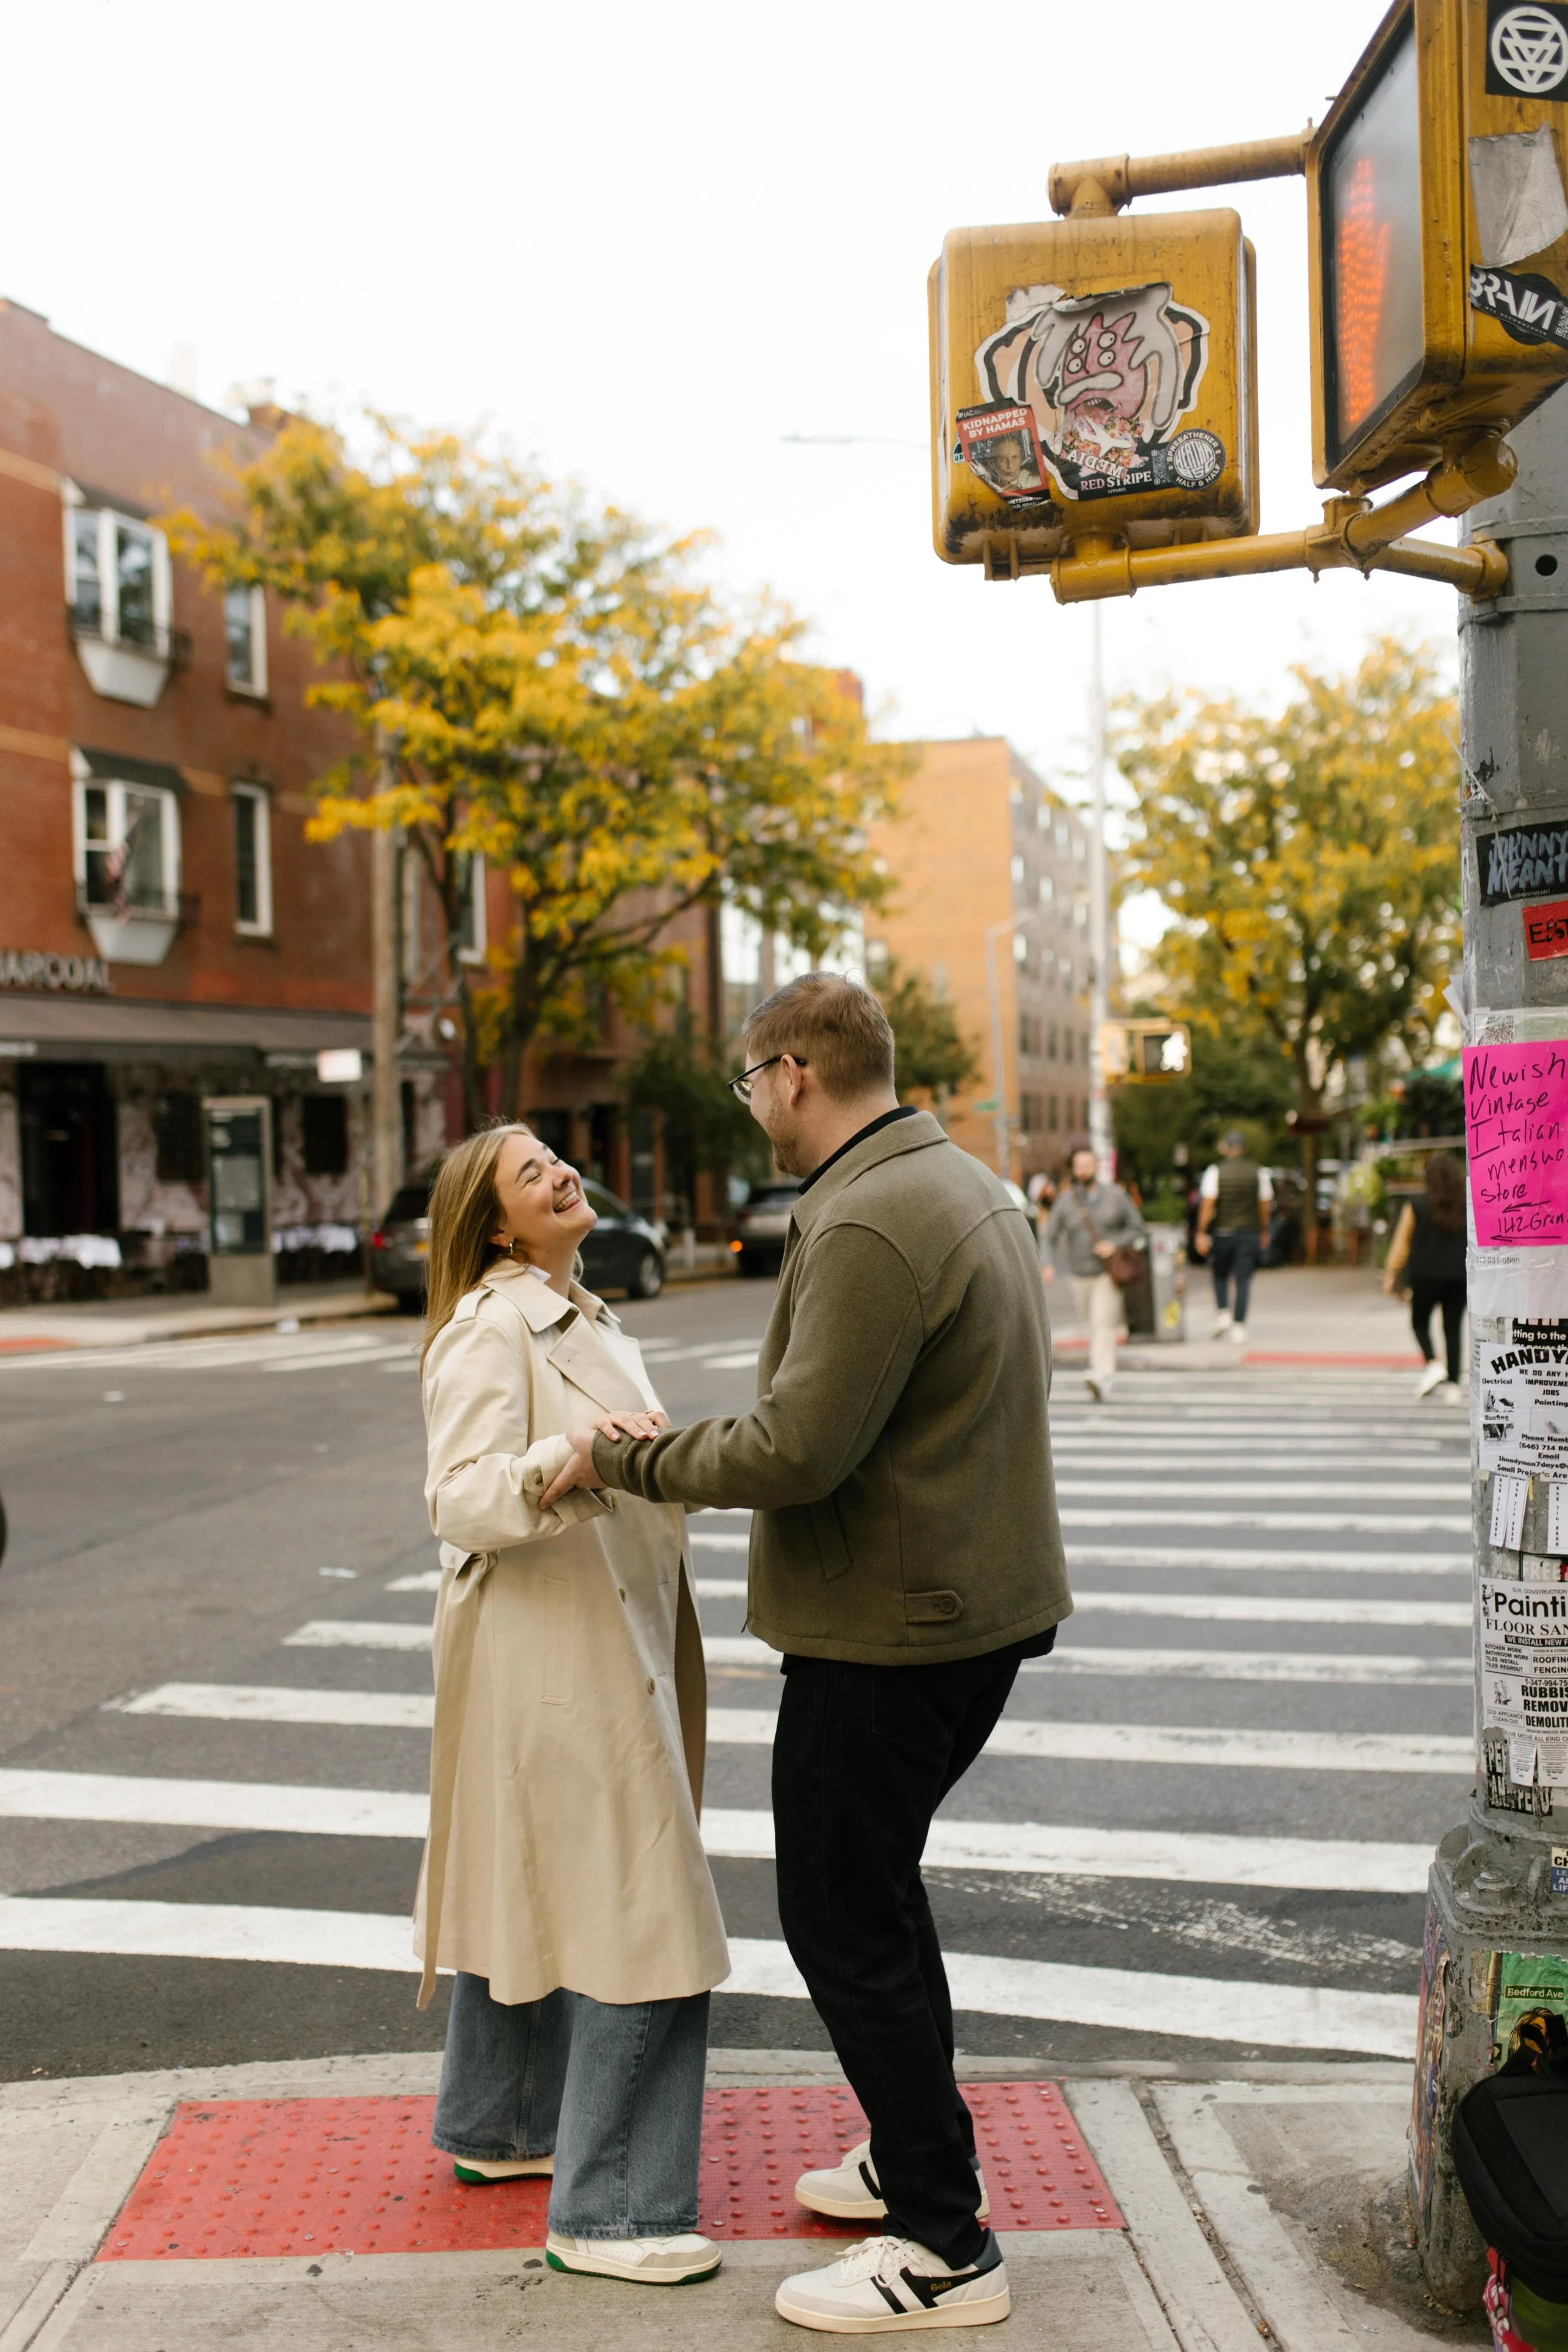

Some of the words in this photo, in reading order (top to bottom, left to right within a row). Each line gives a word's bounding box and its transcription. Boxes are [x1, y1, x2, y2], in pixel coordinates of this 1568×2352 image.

[1470, 269, 1557, 331] BRAIN
[963, 408, 1027, 431] KIDNAPPED
[968, 428, 983, 438] BY
[985, 417, 1025, 434] HAMAS
[1167, 432, 1219, 462] SPREEATHENER
[1080, 478, 1105, 491] RED
[1176, 476, 1196, 488] HALF
[1205, 464, 1221, 483] HALF
[1487, 853, 1568, 895] MEANT
[1470, 1052, 1565, 1095] Newish
[1471, 1091, 1550, 1121] Vintage
[1471, 1118, 1560, 1160] Italian
[1498, 1216, 1529, 1234] 142
[1530, 1212, 1568, 1231] Gran
[1537, 1331, 1547, 1340] to
[1550, 1331, 1566, 1340] the
[1490, 1348, 1568, 1375] HANDY
[1535, 1399, 1568, 1407] Painting
[1497, 1465, 1515, 1473] Small
[1498, 1456, 1568, 1468] 1handyman7days@
[1495, 1592, 1566, 1617] Painti
[1486, 1618, 1535, 1636] FLOOR
[1518, 1637, 1544, 1646] INSTALL
[1485, 1650, 1512, 1658] BATHROOM
[1525, 1678, 1568, 1687] 1-347-994-75
[1523, 1699, 1568, 1712] REMOV
[1498, 1711, 1523, 1719] APPLIANCE
[1507, 1988, 1544, 1997] Bedford
[1546, 1989, 1564, 1998] Ave
[931, 2281, 951, 2292] Gola
